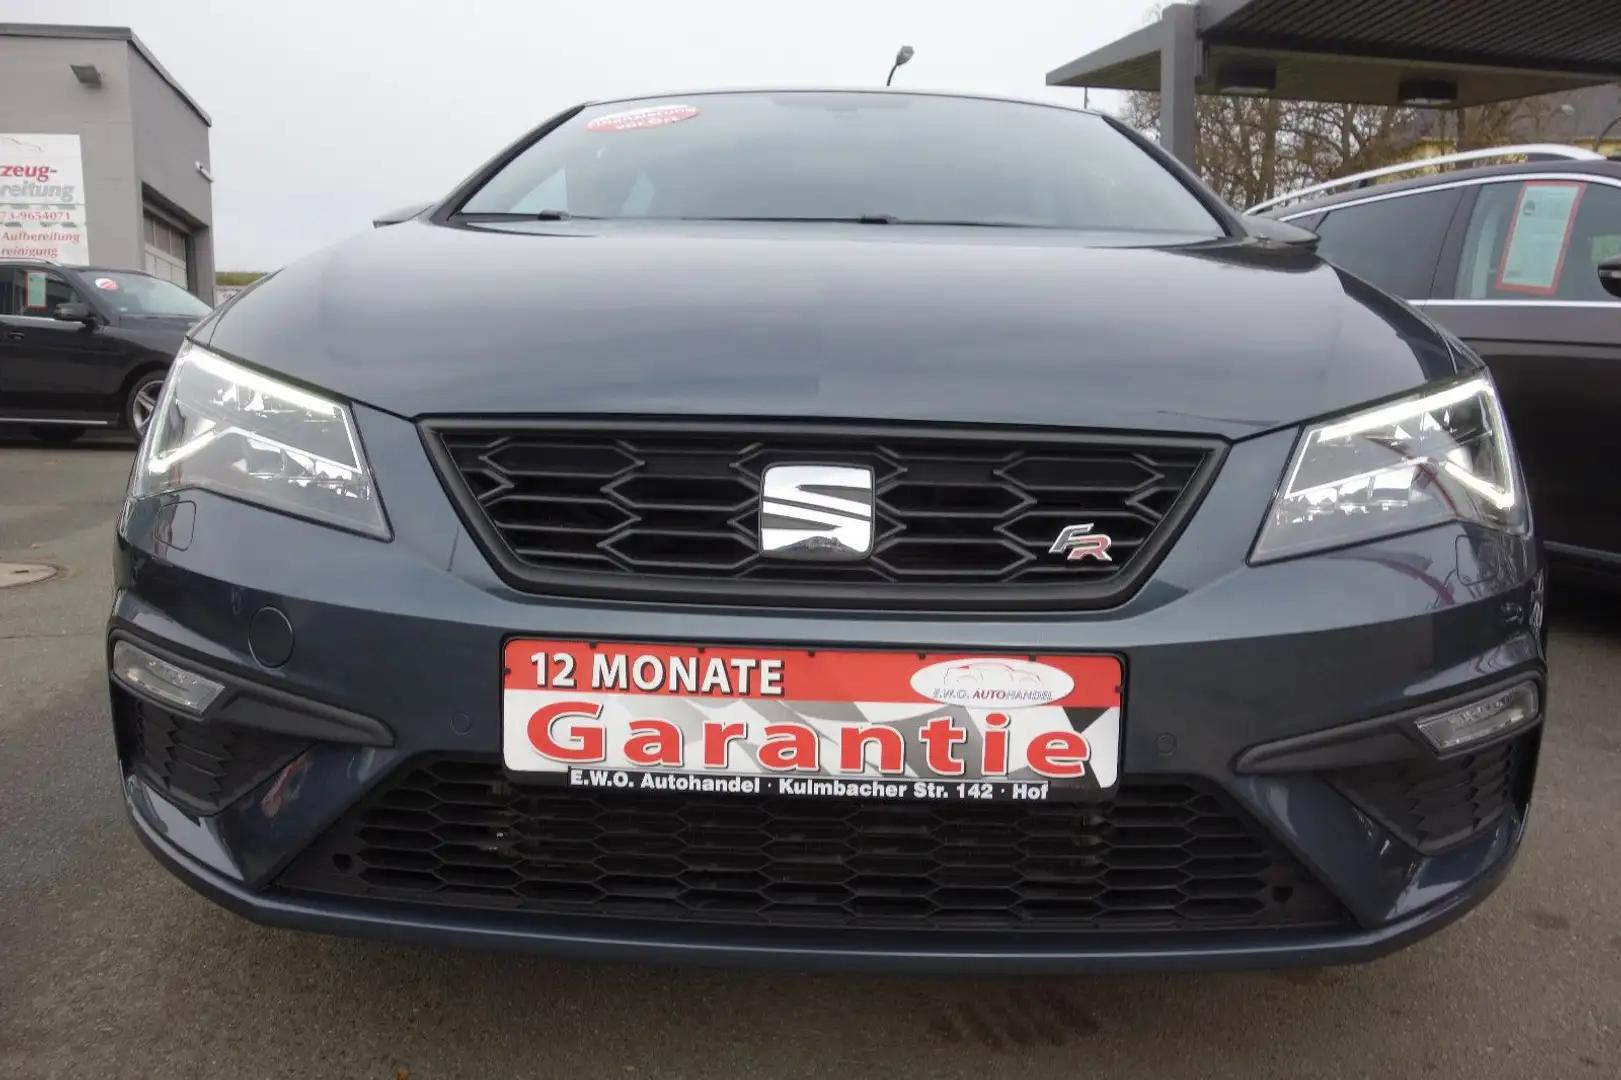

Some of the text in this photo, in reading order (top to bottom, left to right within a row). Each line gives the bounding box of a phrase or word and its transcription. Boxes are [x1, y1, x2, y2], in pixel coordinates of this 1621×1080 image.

[0, 165, 57, 182] zeug-
[1048, 523, 1112, 561] FR
[530, 651, 784, 696] 12 MONATE
[526, 700, 1091, 778] Garantie
[570, 769, 1048, 800] E.W.O. Autohandel Kulmbacher Str. 142 Hof
